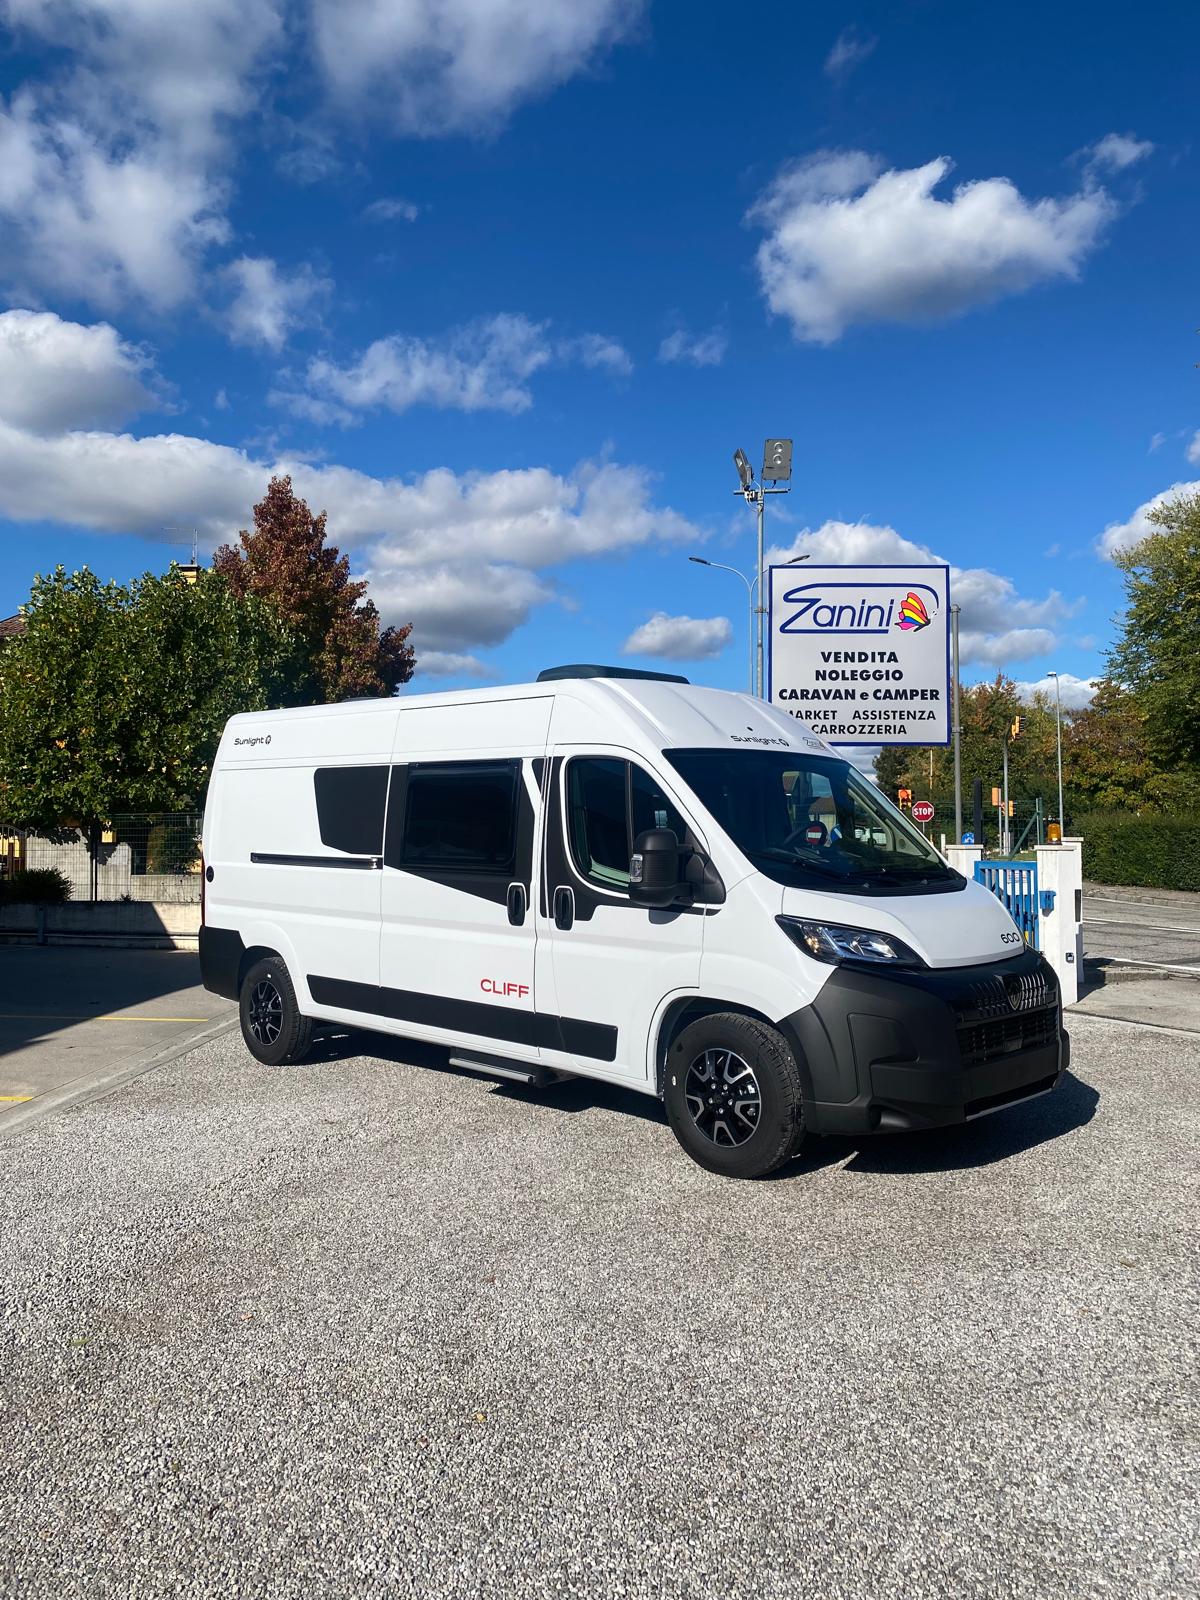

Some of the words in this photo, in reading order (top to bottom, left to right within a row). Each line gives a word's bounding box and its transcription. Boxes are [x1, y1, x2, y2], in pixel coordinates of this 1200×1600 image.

[780, 583, 895, 634] Zanini
[820, 651, 899, 663] VENDITA
[815, 669, 904, 681] NOLEGGIO
[778, 688, 856, 701] CARAVAN
[859, 691, 870, 701] e
[872, 688, 940, 701] CAMPER
[852, 710, 937, 721] ASSISTENZA
[811, 724, 907, 735] CARROZZERIA
[234, 737, 264, 747] Sunlight
[730, 735, 779, 745] Sunlight
[913, 807, 933, 816] STOP
[1000, 932, 1020, 944] 600
[480, 978, 530, 998] CLIFF
